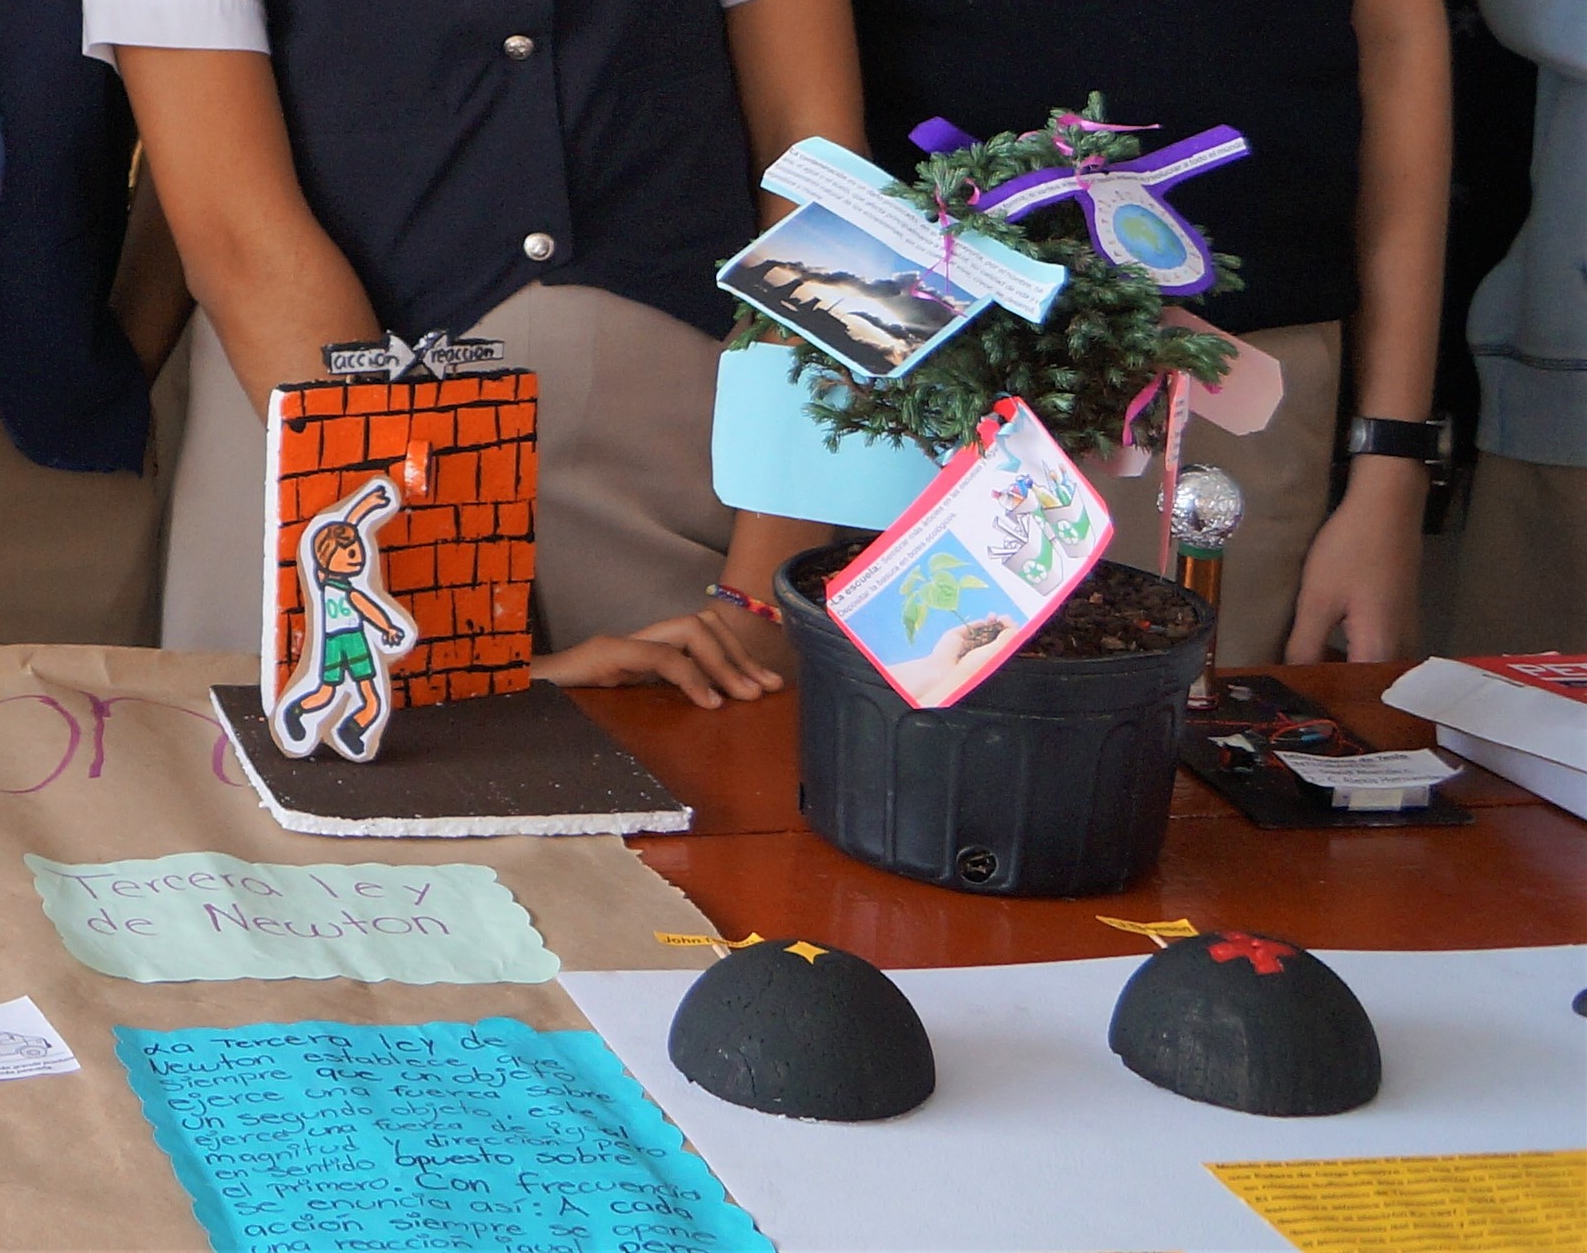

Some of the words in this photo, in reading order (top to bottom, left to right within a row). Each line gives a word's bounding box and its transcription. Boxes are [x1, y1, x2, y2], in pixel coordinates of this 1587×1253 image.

[333, 353, 400, 370] accion
[430, 346, 495, 364] reaccion
[42, 866, 284, 900] Tercera
[308, 873, 432, 906] ley
[86, 908, 159, 936] de
[203, 902, 451, 940] Newton
[460, 1030, 509, 1050] de
[148, 1053, 276, 1076] Newton
[414, 1171, 491, 1194] Con
[558, 1196, 591, 1218] A
